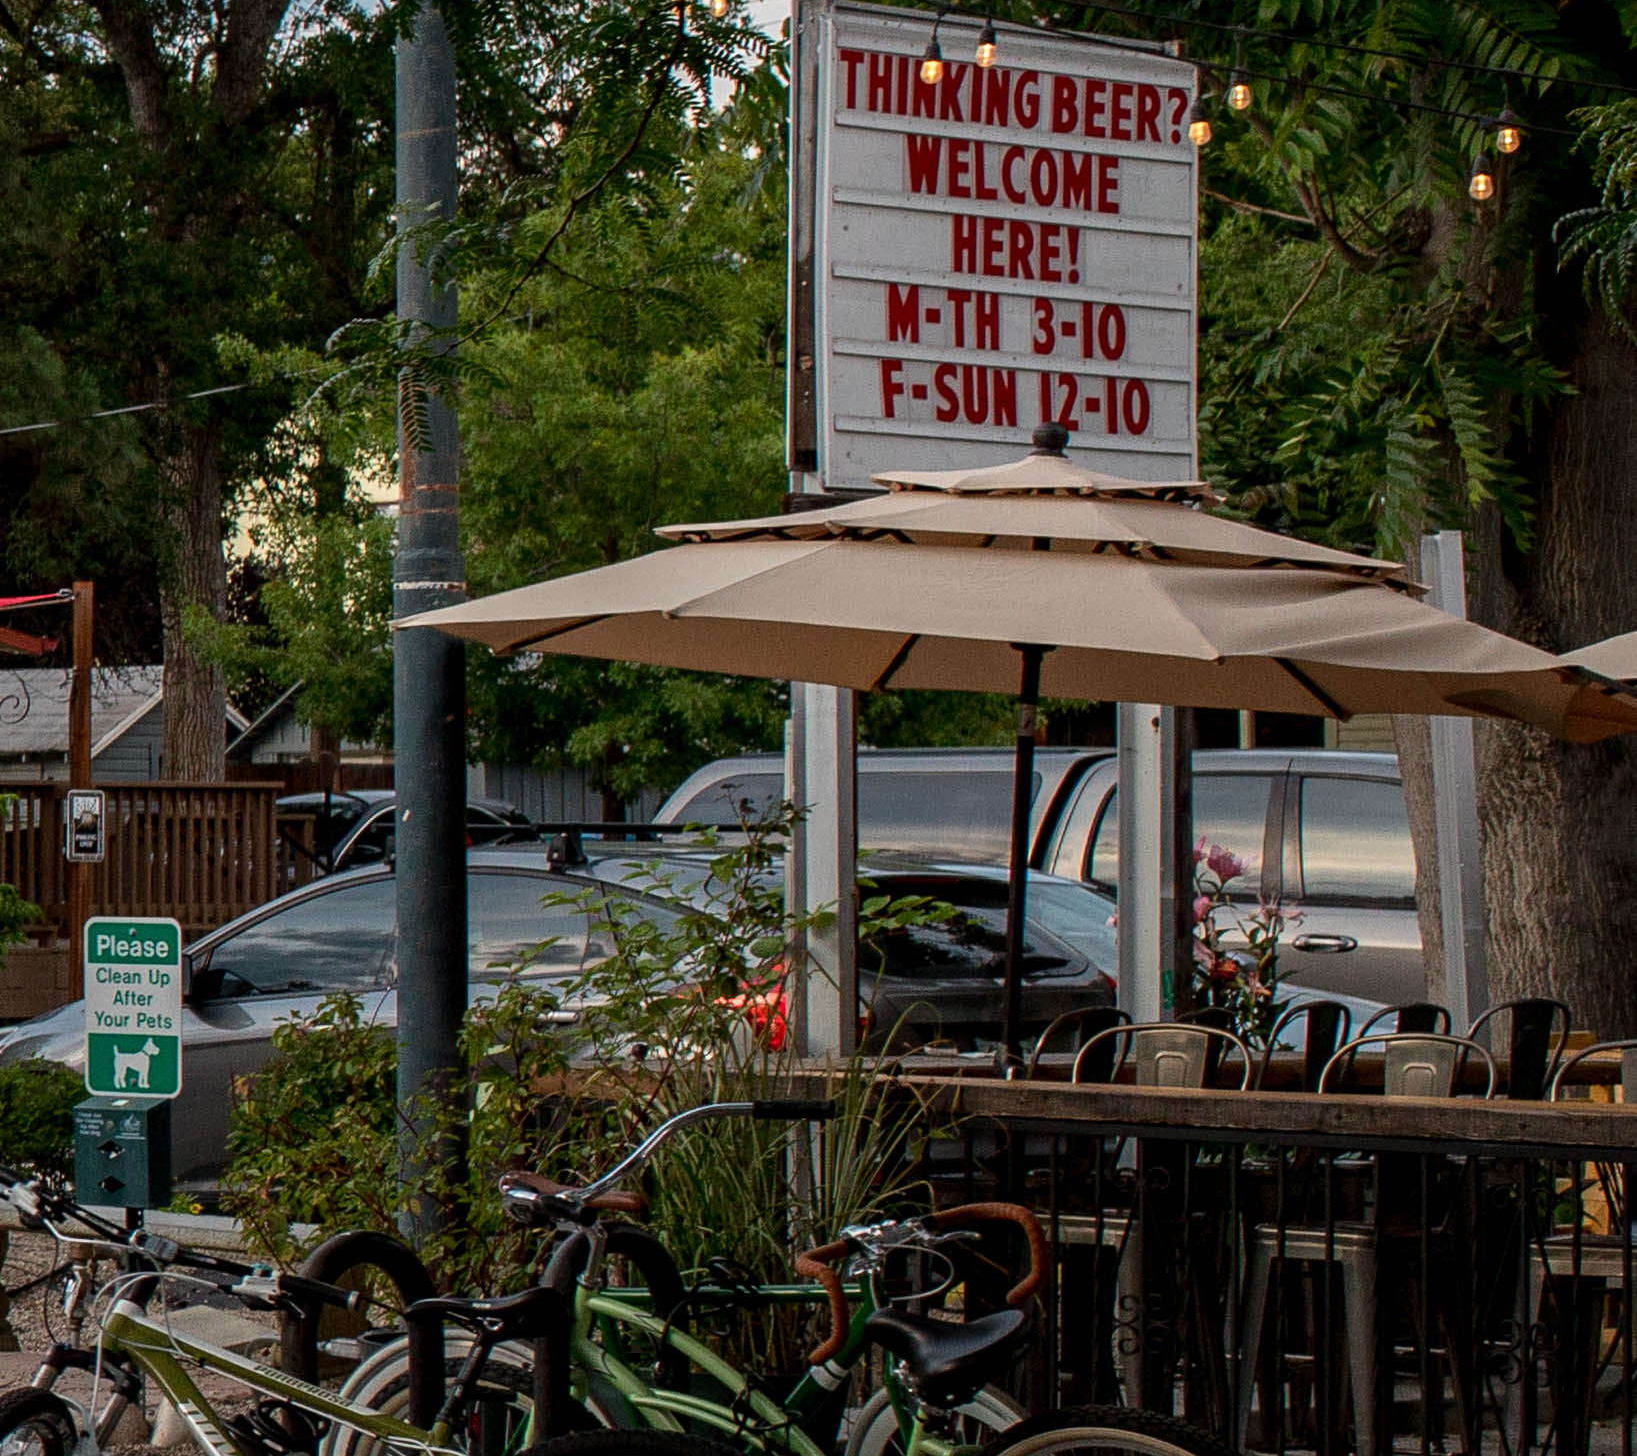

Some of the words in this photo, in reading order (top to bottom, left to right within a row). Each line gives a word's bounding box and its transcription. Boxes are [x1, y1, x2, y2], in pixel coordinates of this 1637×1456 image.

[840, 49, 1040, 128] THINKING
[1052, 76, 1189, 143] BEER?
[907, 134, 1121, 214] WELCOME
[952, 214, 1081, 284] HERE!
[888, 282, 1000, 351] M-TH
[1032, 296, 1127, 361] 3-10
[880, 359, 1018, 427] F-SUN
[1039, 370, 1151, 435] 12-10
[96, 968, 142, 984] Clean
[149, 969, 170, 989] Up
[97, 935, 169, 958] Please
[95, 1011, 130, 1028] Your
[137, 1012, 172, 1030] Pets
[113, 990, 153, 1007] After
